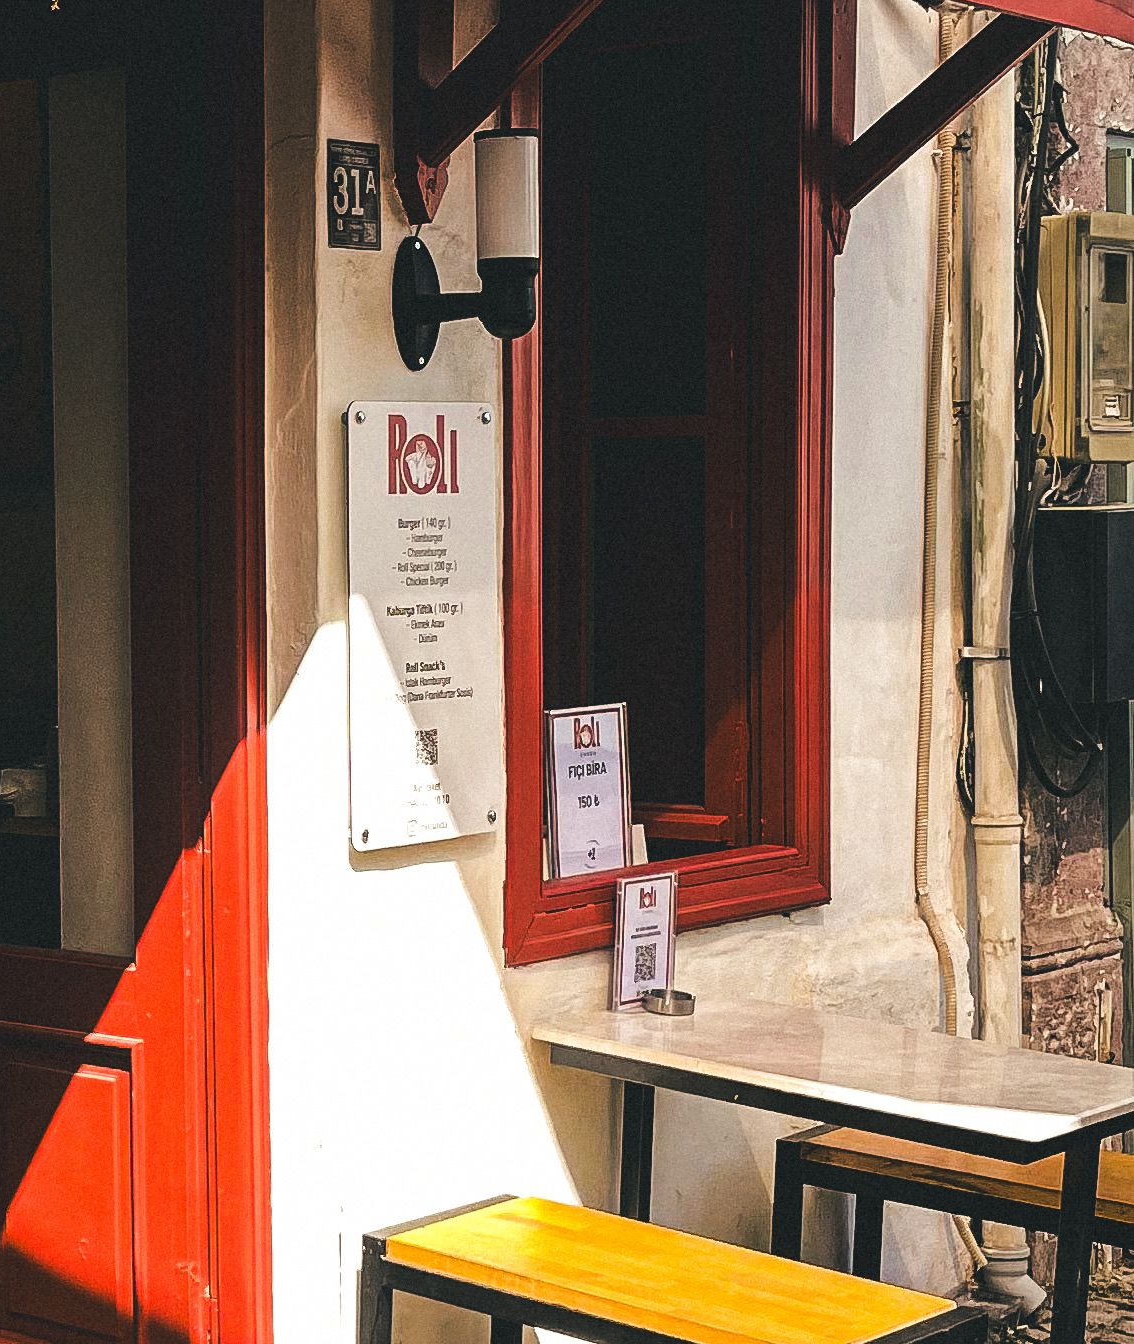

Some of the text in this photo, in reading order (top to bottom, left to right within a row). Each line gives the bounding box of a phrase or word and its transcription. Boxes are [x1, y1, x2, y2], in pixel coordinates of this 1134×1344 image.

[388, 414, 460, 495] Roll
[398, 518, 420, 531] Burger
[586, 760, 607, 776] BİRA
[578, 795, 592, 808] 150
